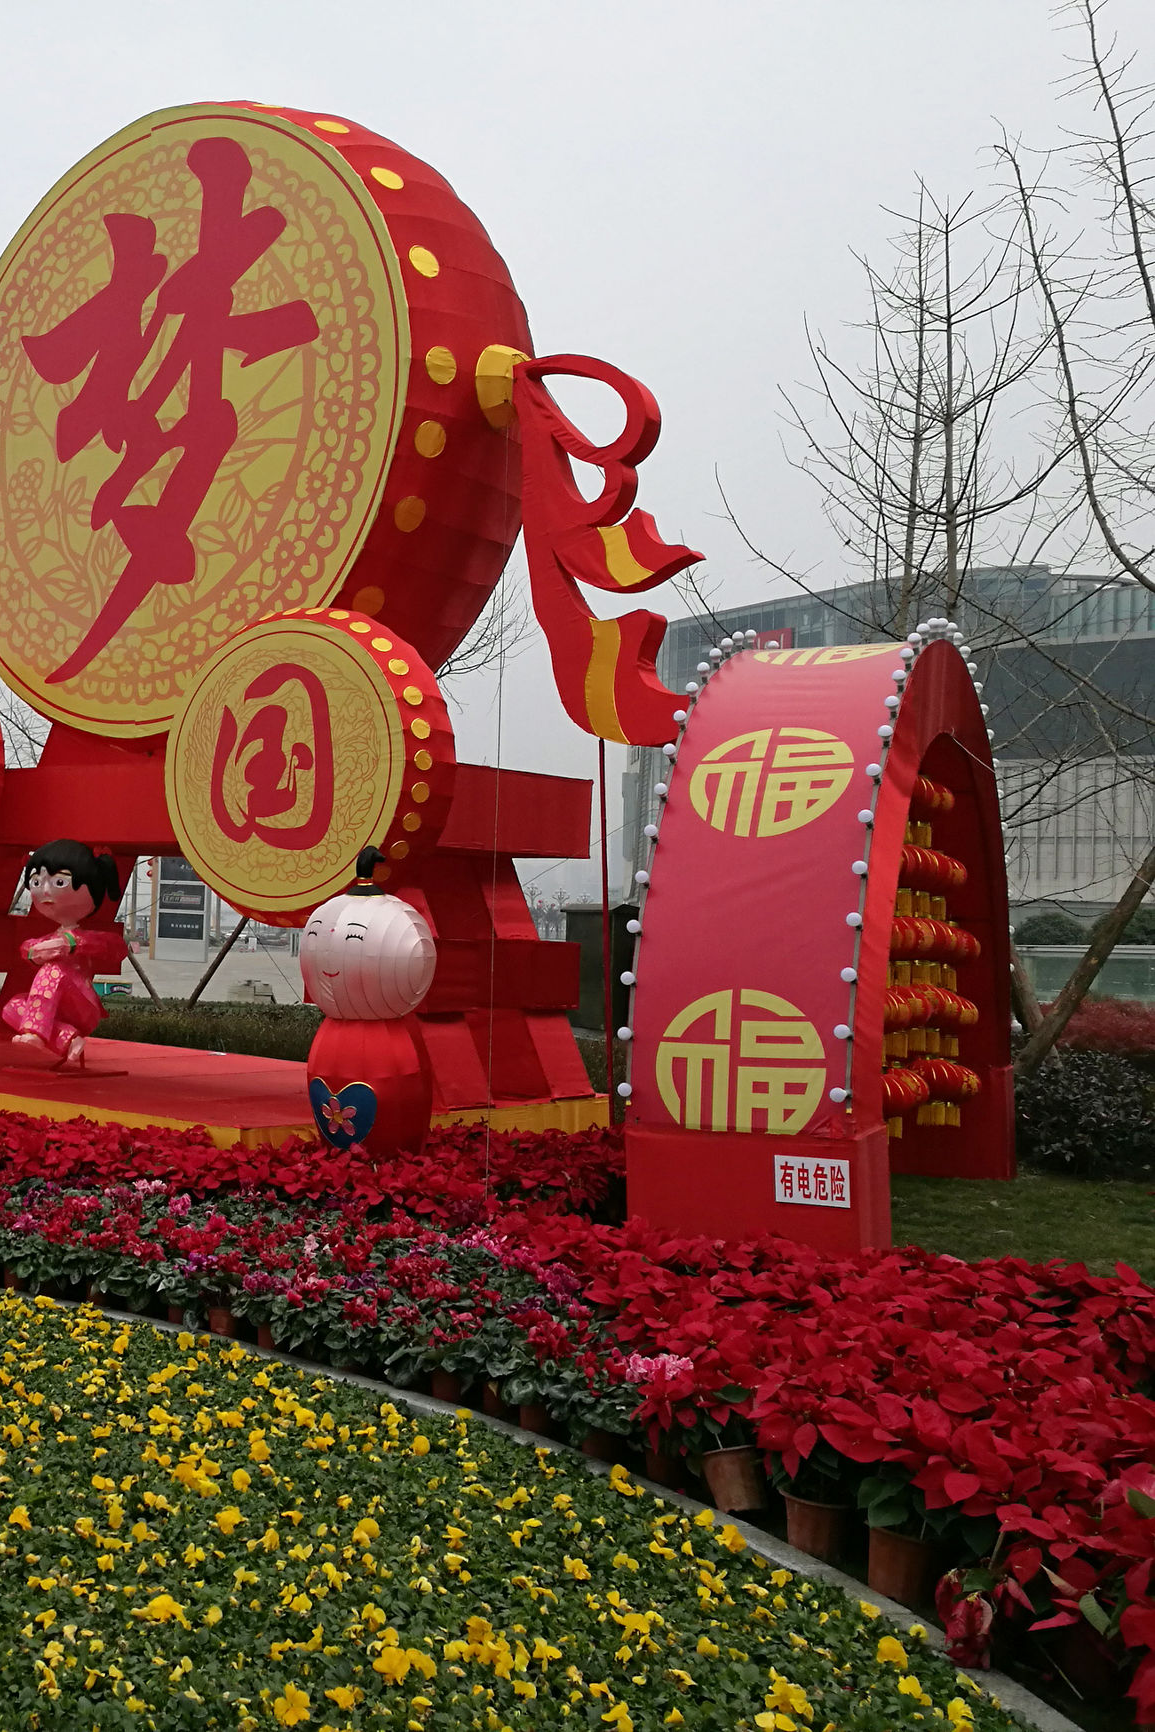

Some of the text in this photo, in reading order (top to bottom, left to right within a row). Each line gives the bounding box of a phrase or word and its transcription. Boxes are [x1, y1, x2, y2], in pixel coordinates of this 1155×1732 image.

[22, 137, 320, 684] 梦
[210, 663, 334, 850] 国
[689, 727, 854, 837] 福
[656, 989, 826, 1135] 福
[780, 1161, 845, 1201] 有电危险
